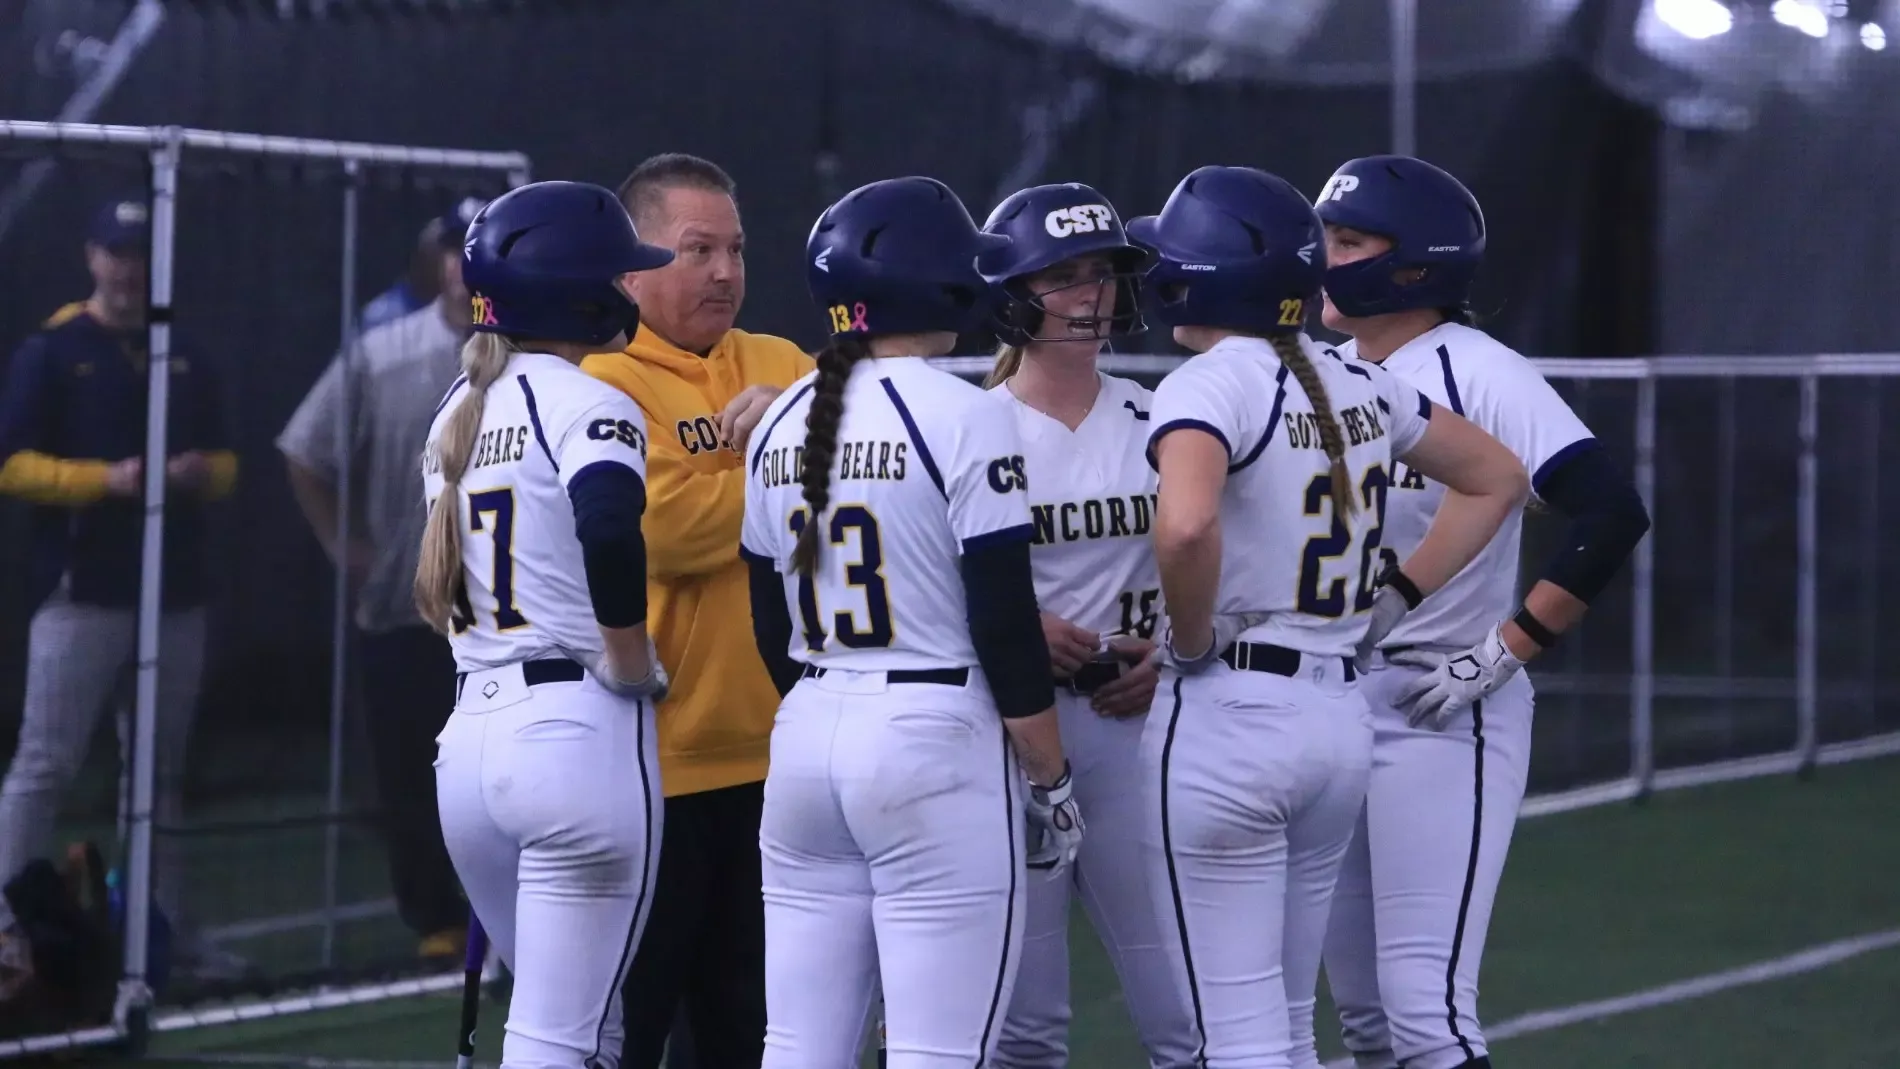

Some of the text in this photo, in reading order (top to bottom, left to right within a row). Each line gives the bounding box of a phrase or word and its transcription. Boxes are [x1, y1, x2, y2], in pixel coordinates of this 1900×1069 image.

[1181, 263, 1216, 272] EASTON
[829, 304, 851, 334] 13
[1276, 299, 1302, 326] 22
[474, 425, 528, 469] BEARS
[586, 418, 646, 462] CS
[762, 440, 907, 489] GOLD BEARS
[987, 454, 1029, 494] CS
[1030, 493, 1158, 545] NCORD
[1294, 461, 1388, 620] 22
[786, 502, 894, 653] 13
